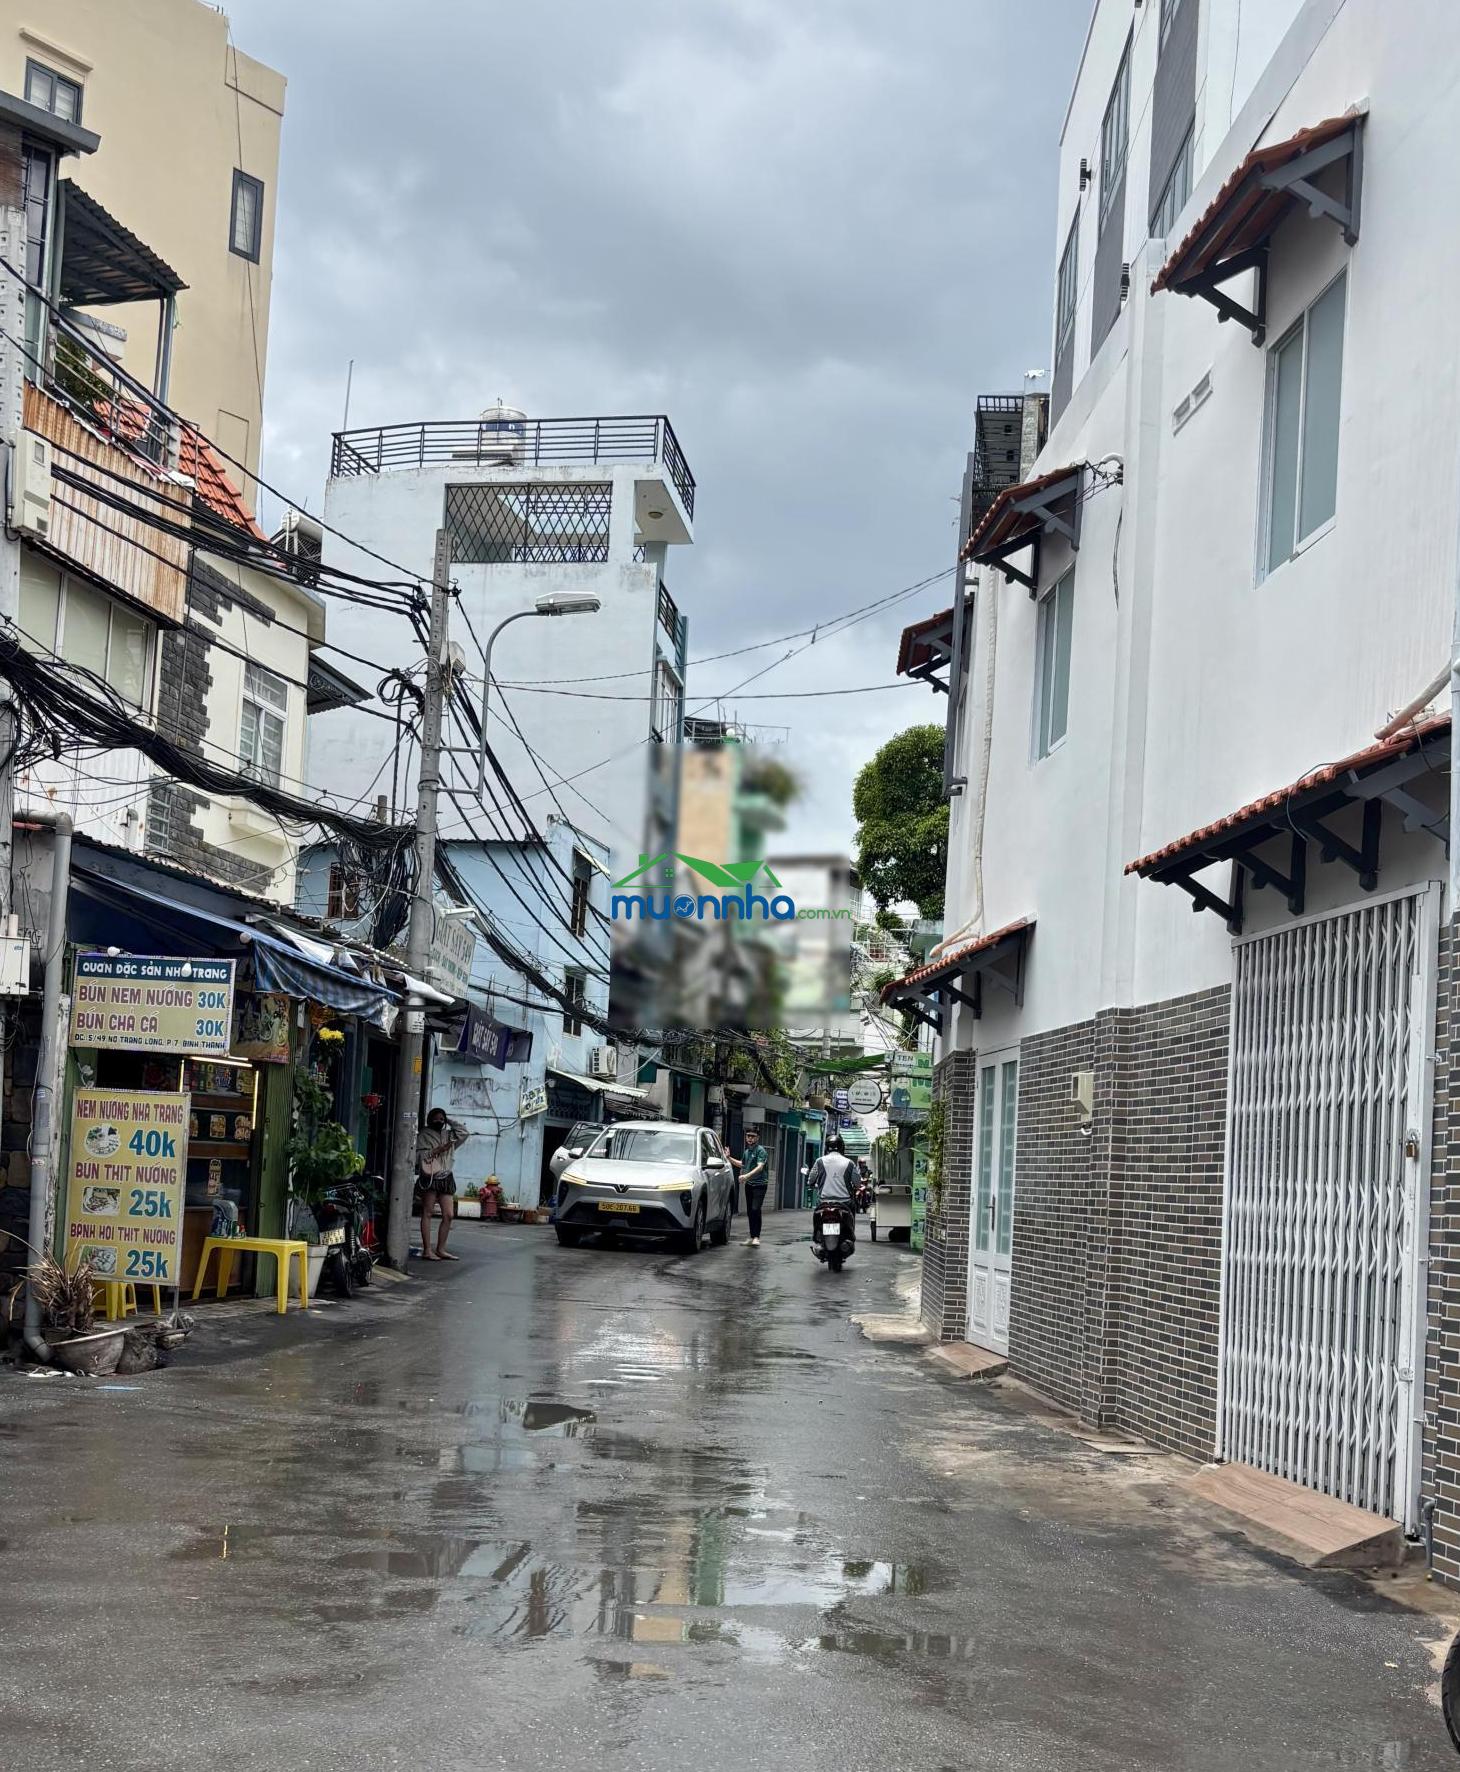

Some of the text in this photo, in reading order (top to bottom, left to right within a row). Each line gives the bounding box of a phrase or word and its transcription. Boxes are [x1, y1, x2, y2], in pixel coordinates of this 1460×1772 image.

[165, 966, 192, 977] NH
[79, 980, 226, 1009] BÚN NEM NƯỚNG 30K
[76, 1006, 105, 1029] BÚN
[140, 1011, 159, 1033] CÁ
[196, 1019, 224, 1037] 30K
[120, 1036, 142, 1044] TRANG
[77, 1099, 97, 1119] NEM
[132, 1102, 150, 1121] NHA
[154, 1104, 184, 1124] TRANG
[75, 1157, 99, 1180] BÚN
